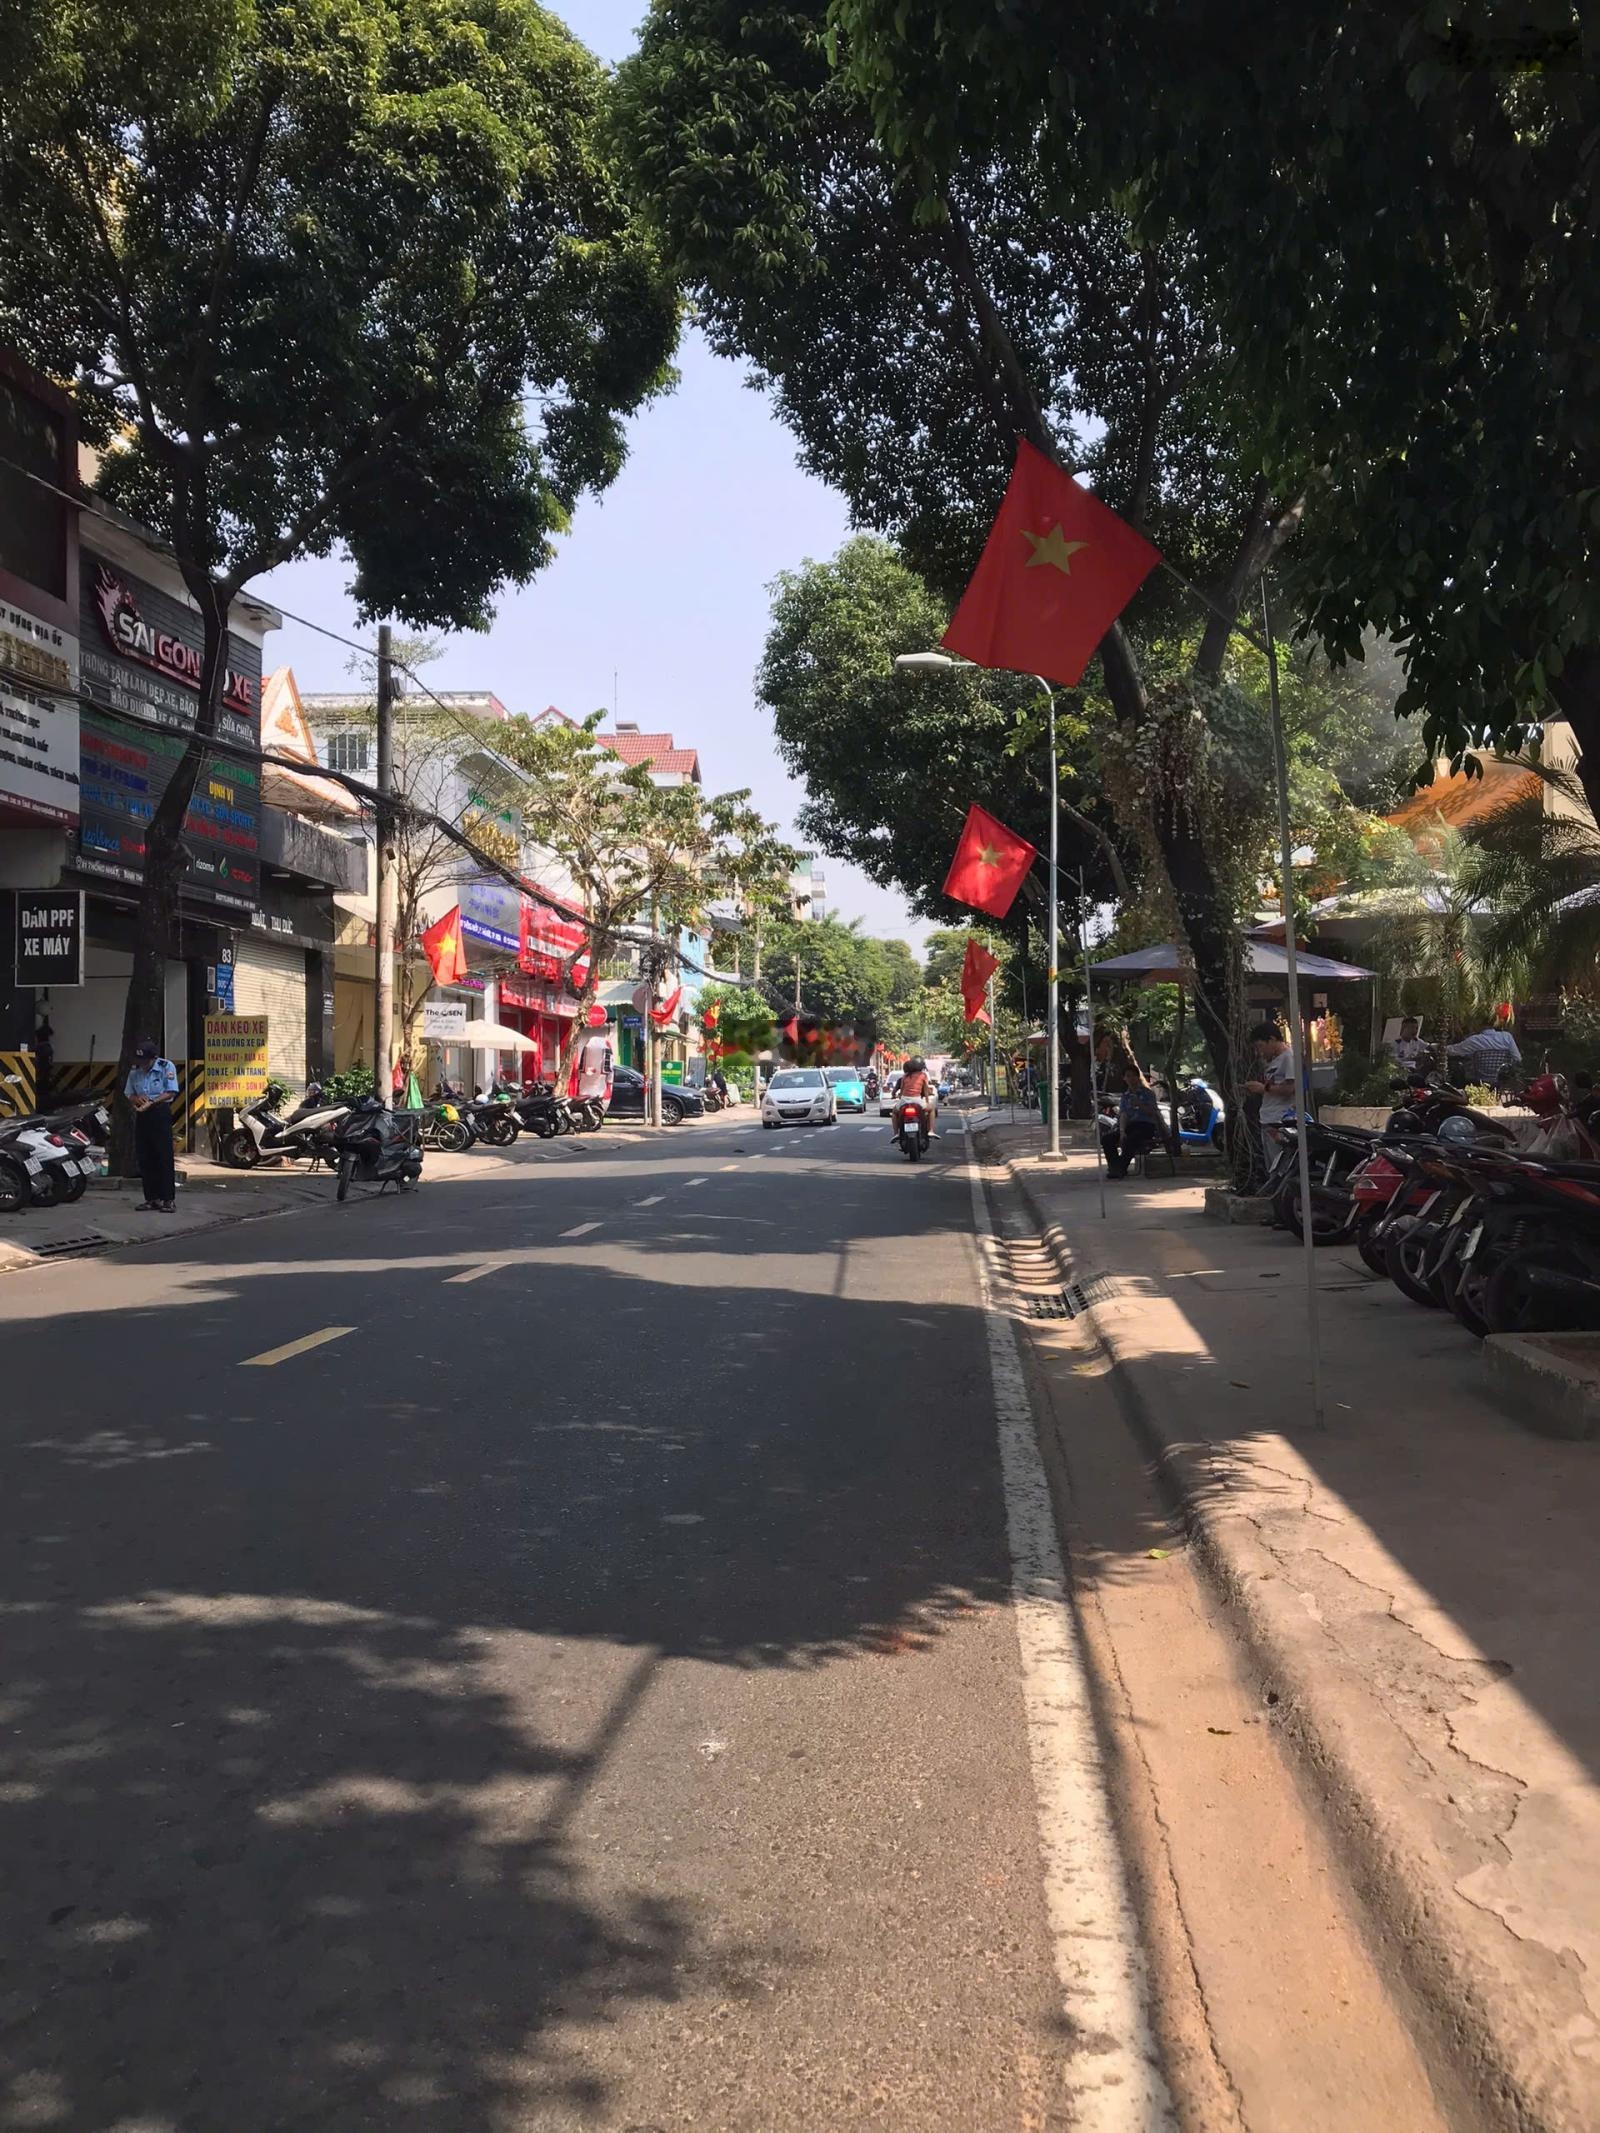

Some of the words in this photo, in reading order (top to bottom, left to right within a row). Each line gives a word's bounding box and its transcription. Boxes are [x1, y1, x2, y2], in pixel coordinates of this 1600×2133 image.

[232, 672, 253, 704] XE
[22, 906, 48, 928] DÁN
[50, 909, 74, 928] PPF
[24, 938, 40, 956] XE
[43, 934, 70, 956] MÁY
[222, 948, 232, 963] 83
[252, 1020, 264, 1034] XE
[247, 1038, 255, 1047] XE
